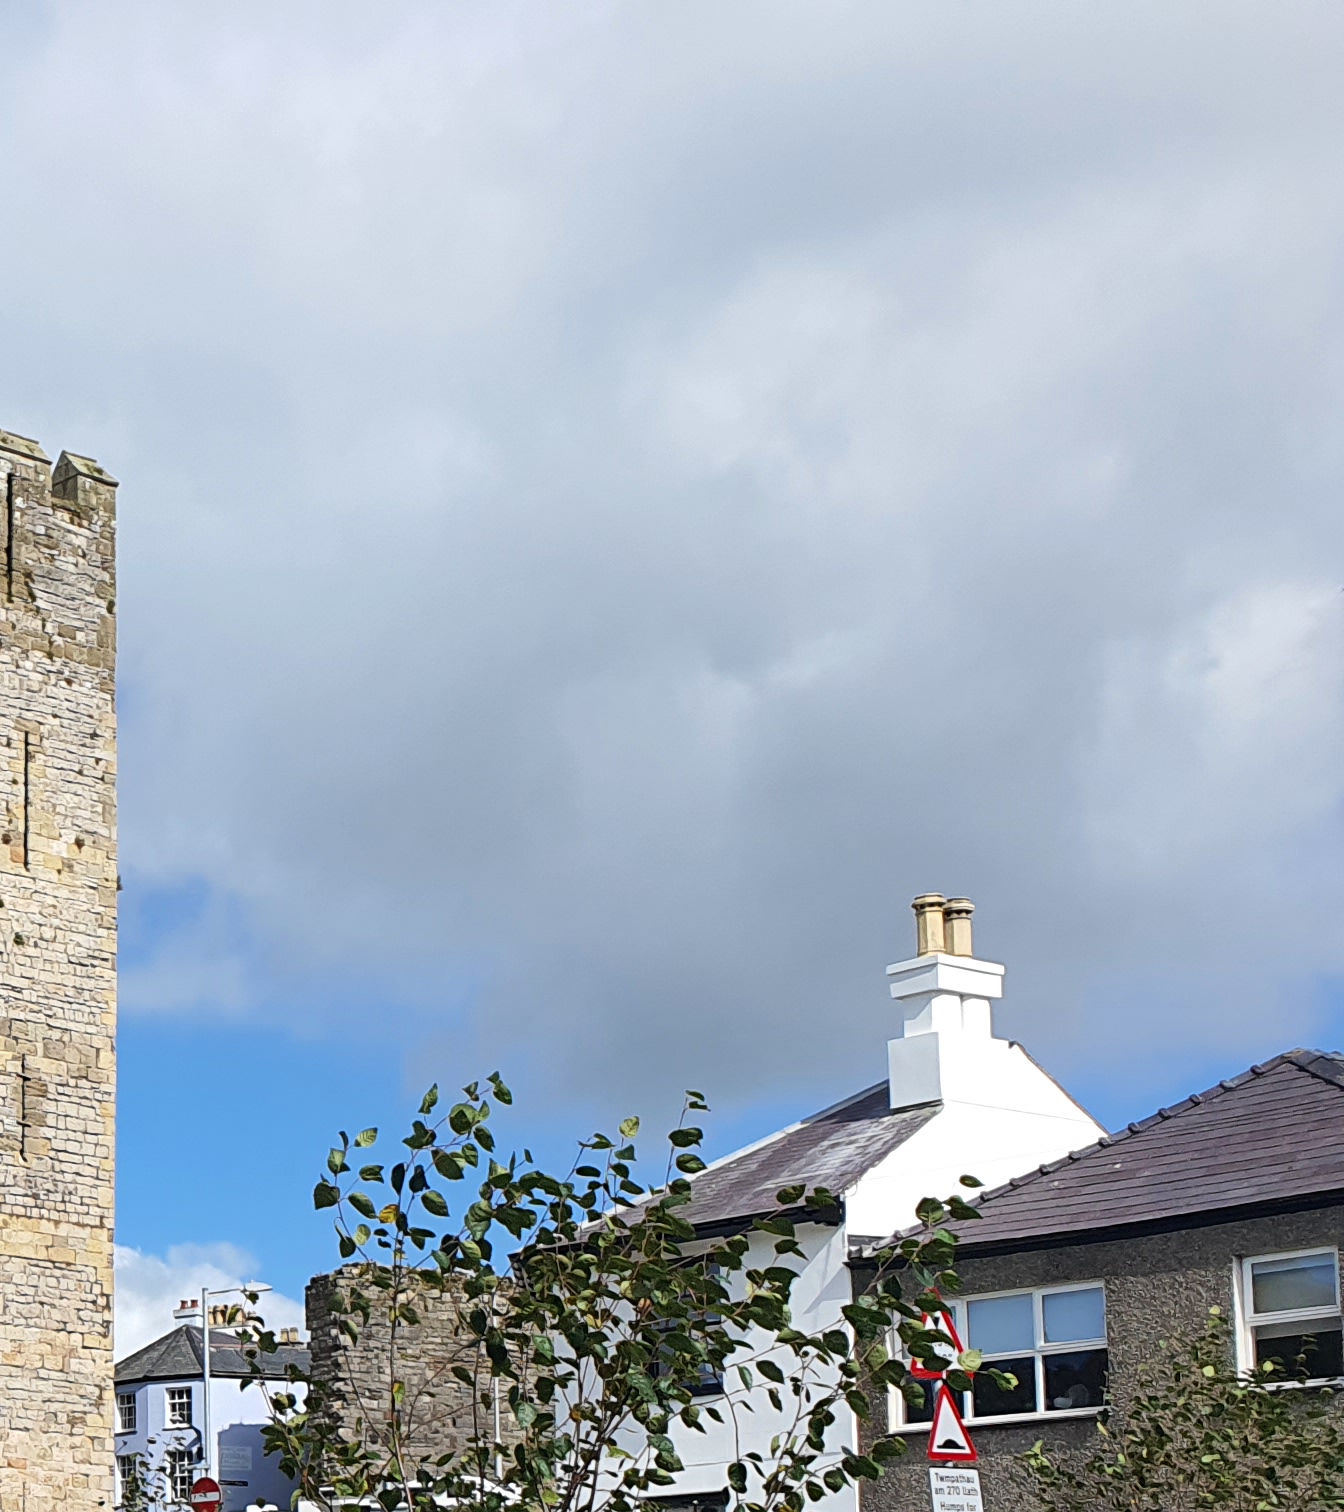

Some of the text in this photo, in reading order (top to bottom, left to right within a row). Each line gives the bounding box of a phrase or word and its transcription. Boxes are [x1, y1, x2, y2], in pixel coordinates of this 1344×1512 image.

[934, 1488, 945, 1496] am
[947, 1486, 961, 1496] 270
[940, 1501, 977, 1512] Humps for
